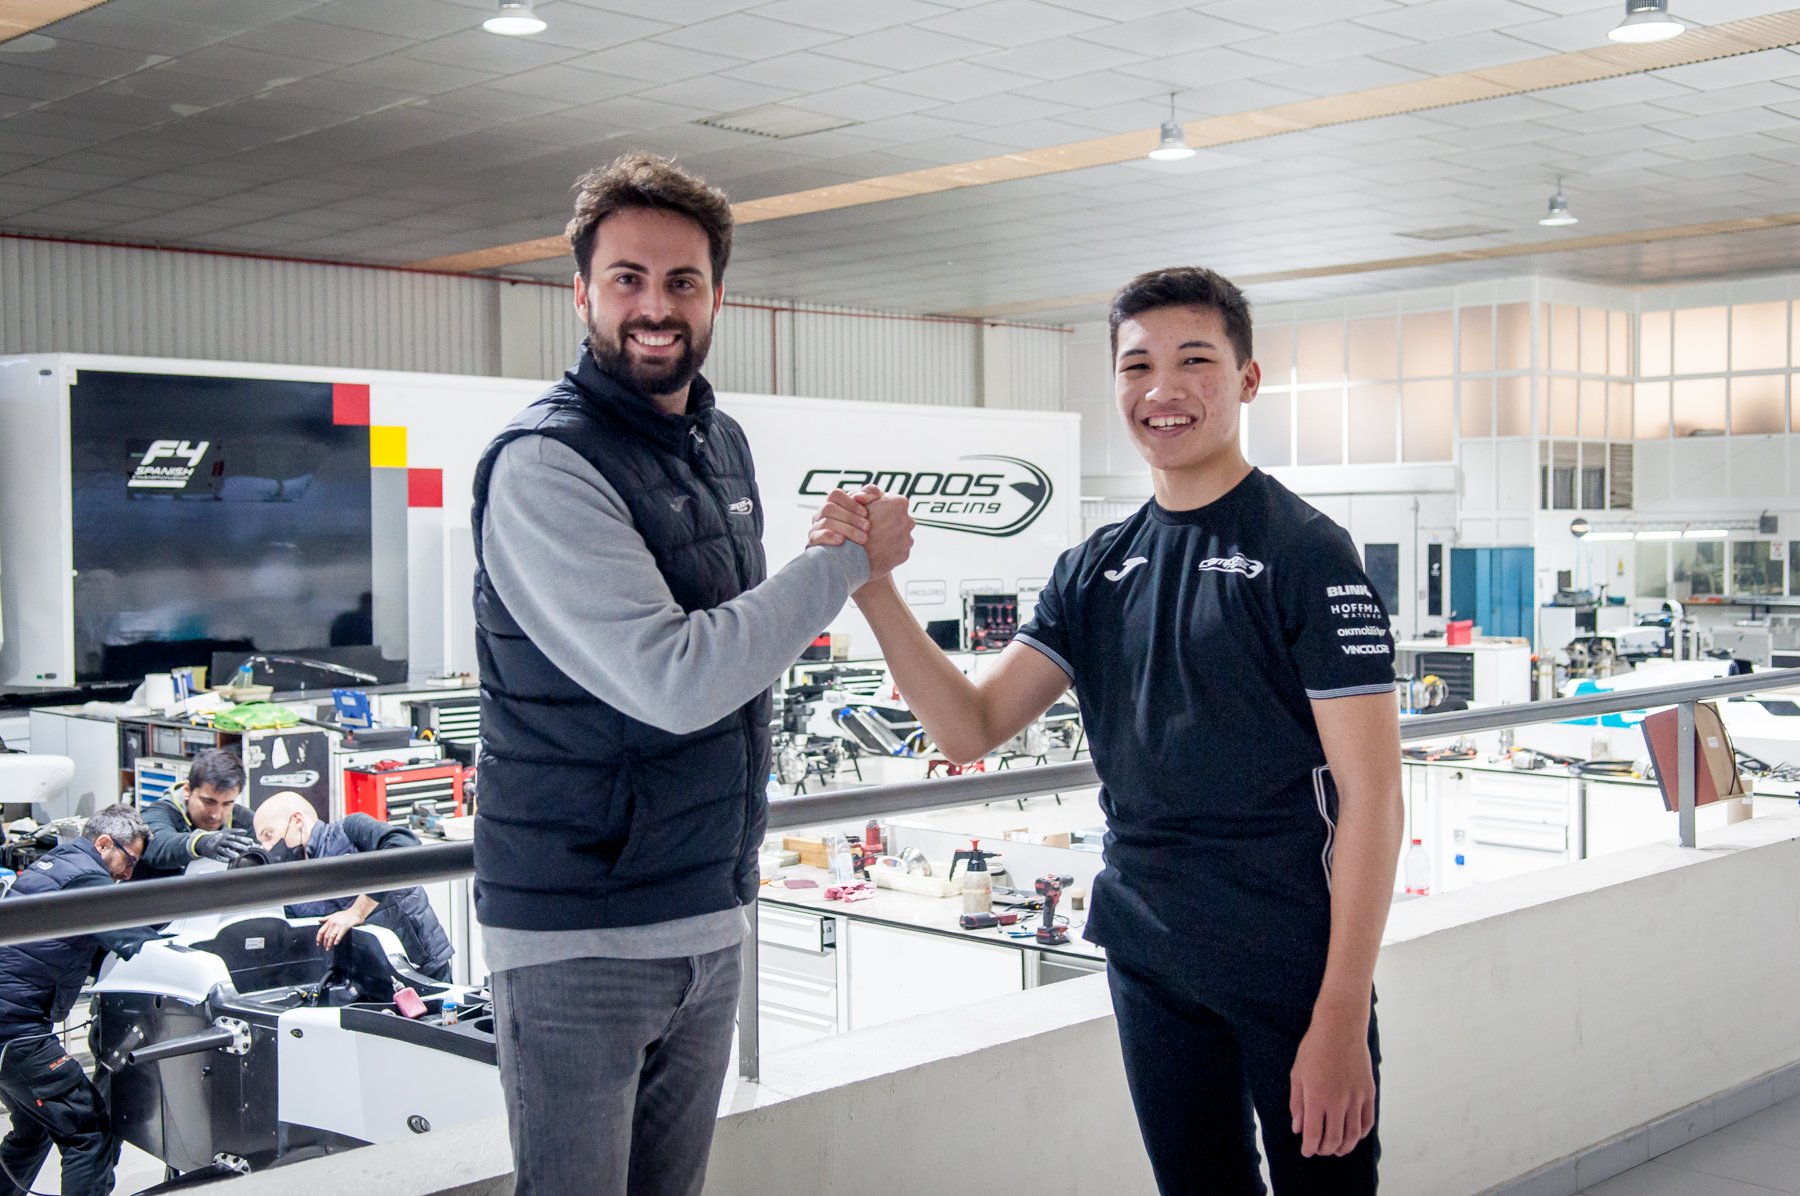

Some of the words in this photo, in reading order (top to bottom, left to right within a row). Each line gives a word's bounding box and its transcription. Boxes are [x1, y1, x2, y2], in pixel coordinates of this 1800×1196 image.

[140, 440, 210, 467] F4
[134, 466, 195, 477] SPANISH
[912, 502, 1002, 514] racing
